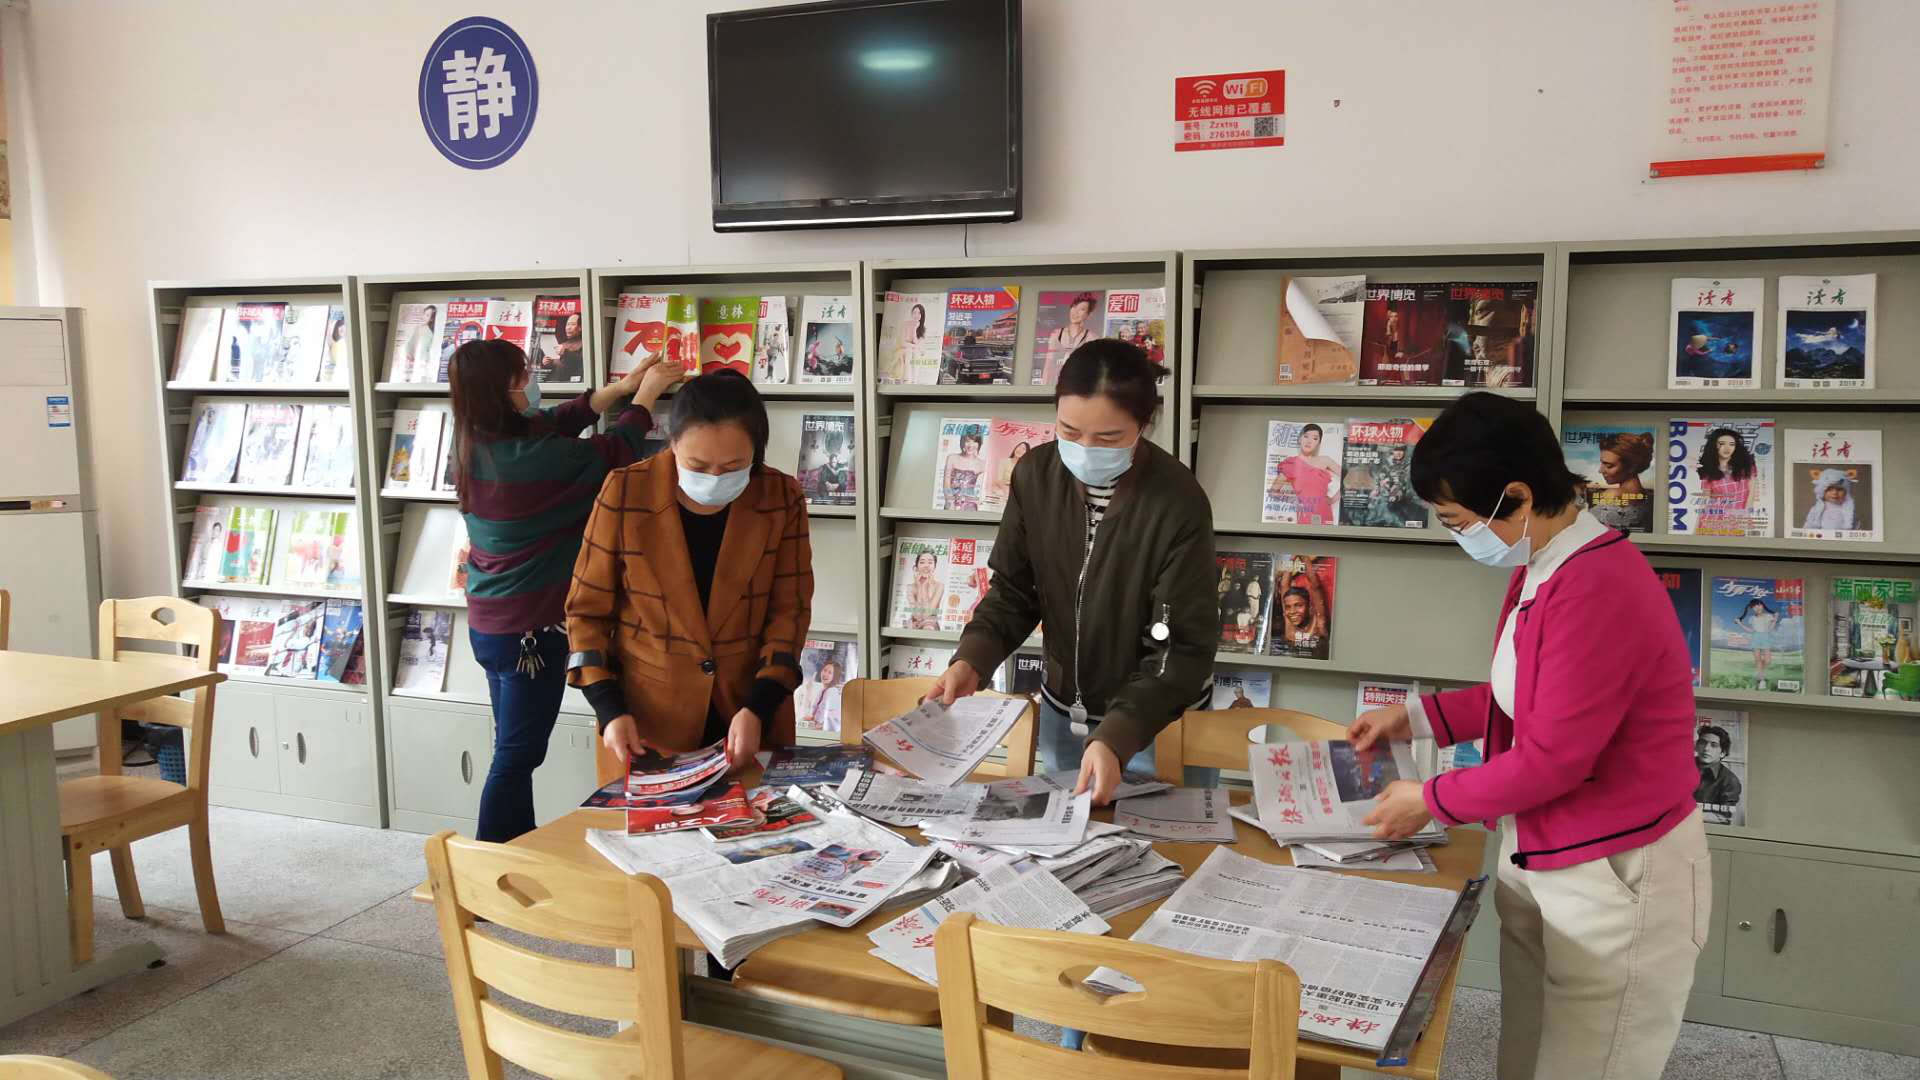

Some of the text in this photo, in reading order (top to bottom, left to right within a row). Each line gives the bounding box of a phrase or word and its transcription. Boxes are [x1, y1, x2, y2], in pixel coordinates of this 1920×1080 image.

[442, 47, 516, 141] 静
[1188, 102, 1272, 118] 无线网络已覆盖
[949, 293, 995, 305] 环球人物
[1366, 289, 1416, 301] 世界博览
[1450, 288, 1505, 300] 世界博览
[1697, 288, 1737, 306] 读者
[1807, 288, 1848, 306] 读者
[448, 302, 485, 314] 环球人物
[538, 301, 576, 313] 环球人物
[618, 295, 652, 309] 家庭
[1109, 294, 1139, 312] 爱你
[717, 303, 743, 320] 意林
[1350, 425, 1404, 439] 环球人物
[1812, 440, 1853, 458] 读者
[1668, 421, 1689, 532] BOSOM
[1833, 579, 1913, 602] 瑞丽家居
[1018, 658, 1042, 671] 世界
[1363, 692, 1408, 705] 特别关注
